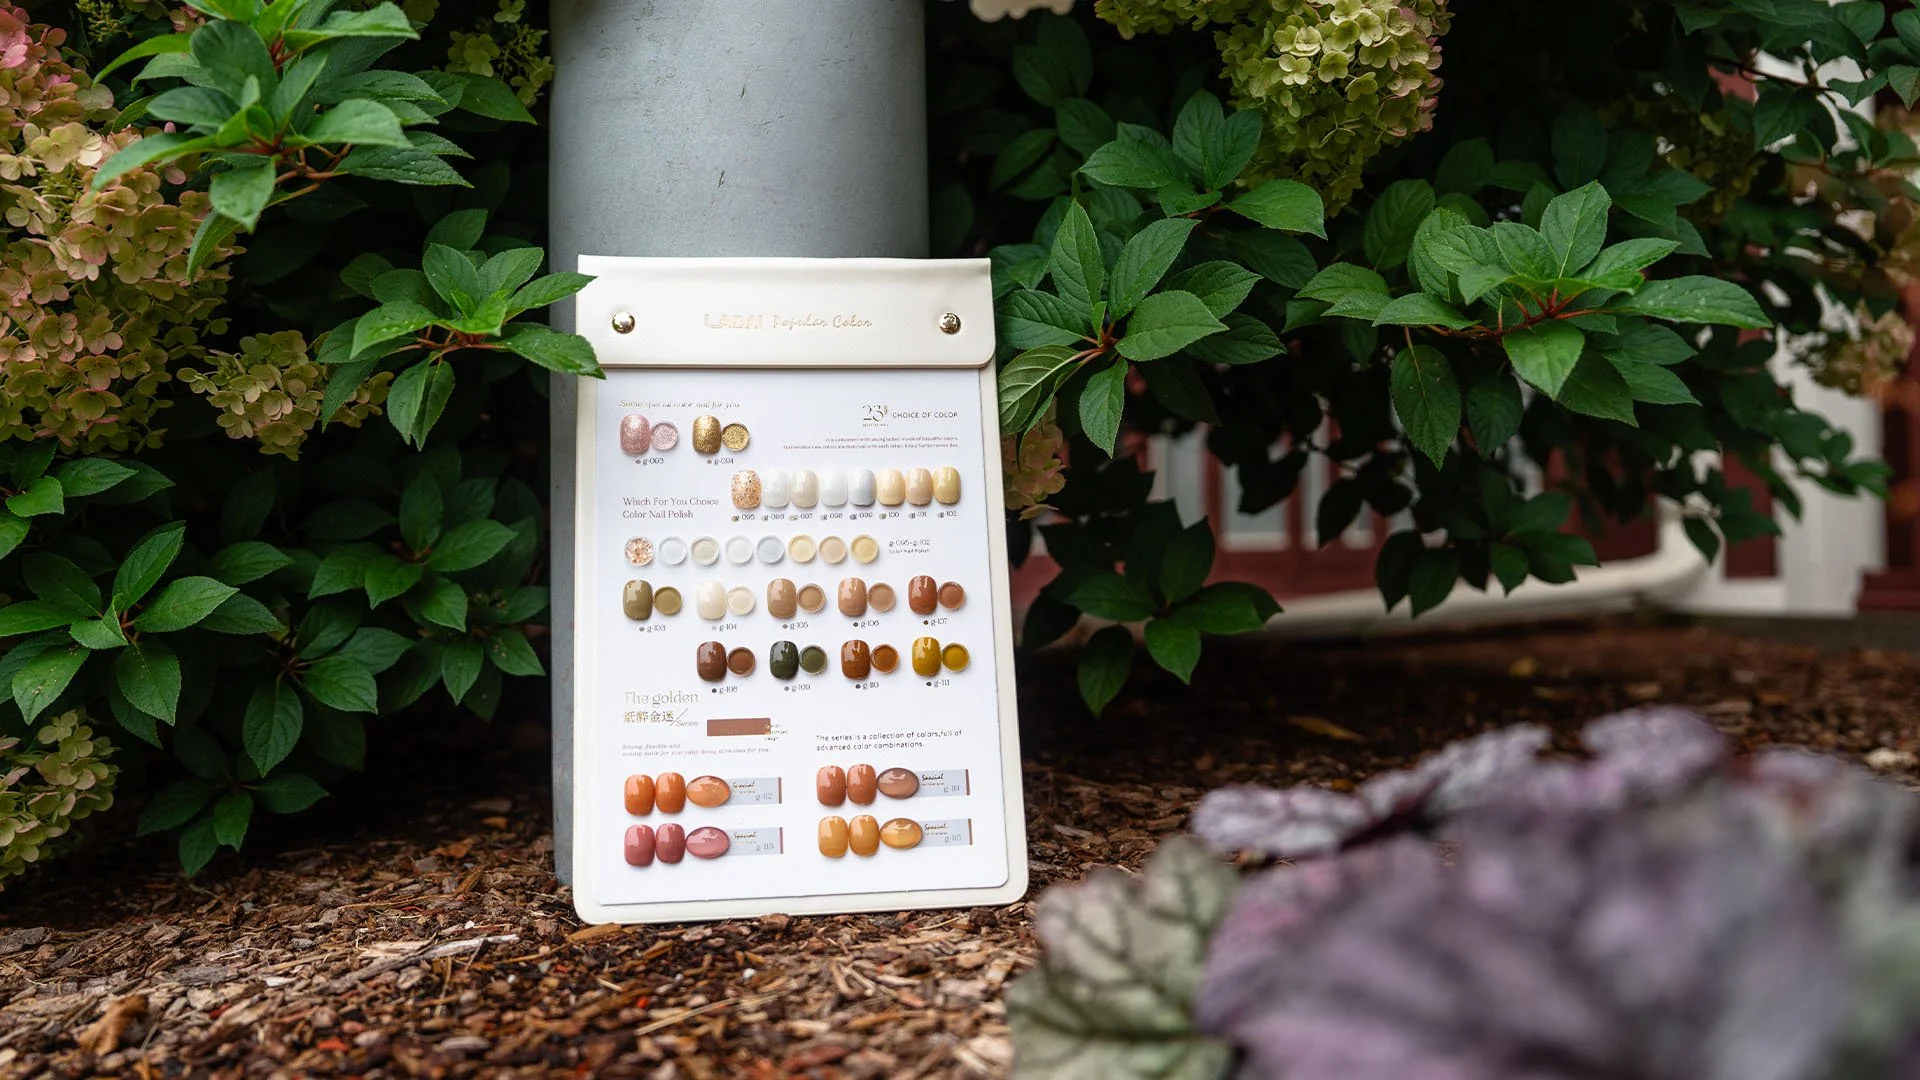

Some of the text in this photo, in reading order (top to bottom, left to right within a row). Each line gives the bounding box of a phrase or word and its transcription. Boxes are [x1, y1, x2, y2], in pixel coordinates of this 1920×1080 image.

[773, 313, 828, 331] Popular
[833, 313, 873, 328] Color
[862, 404, 884, 422] 23
[892, 411, 958, 419] CHOICE OF COLOR
[622, 496, 719, 506] Which For You Choice
[622, 510, 694, 520] Color Nail Polish
[624, 690, 698, 708] The golden
[869, 732, 905, 740] collection
[906, 731, 914, 739] of
[816, 743, 851, 751] advanced
[873, 741, 925, 749] combinations.
